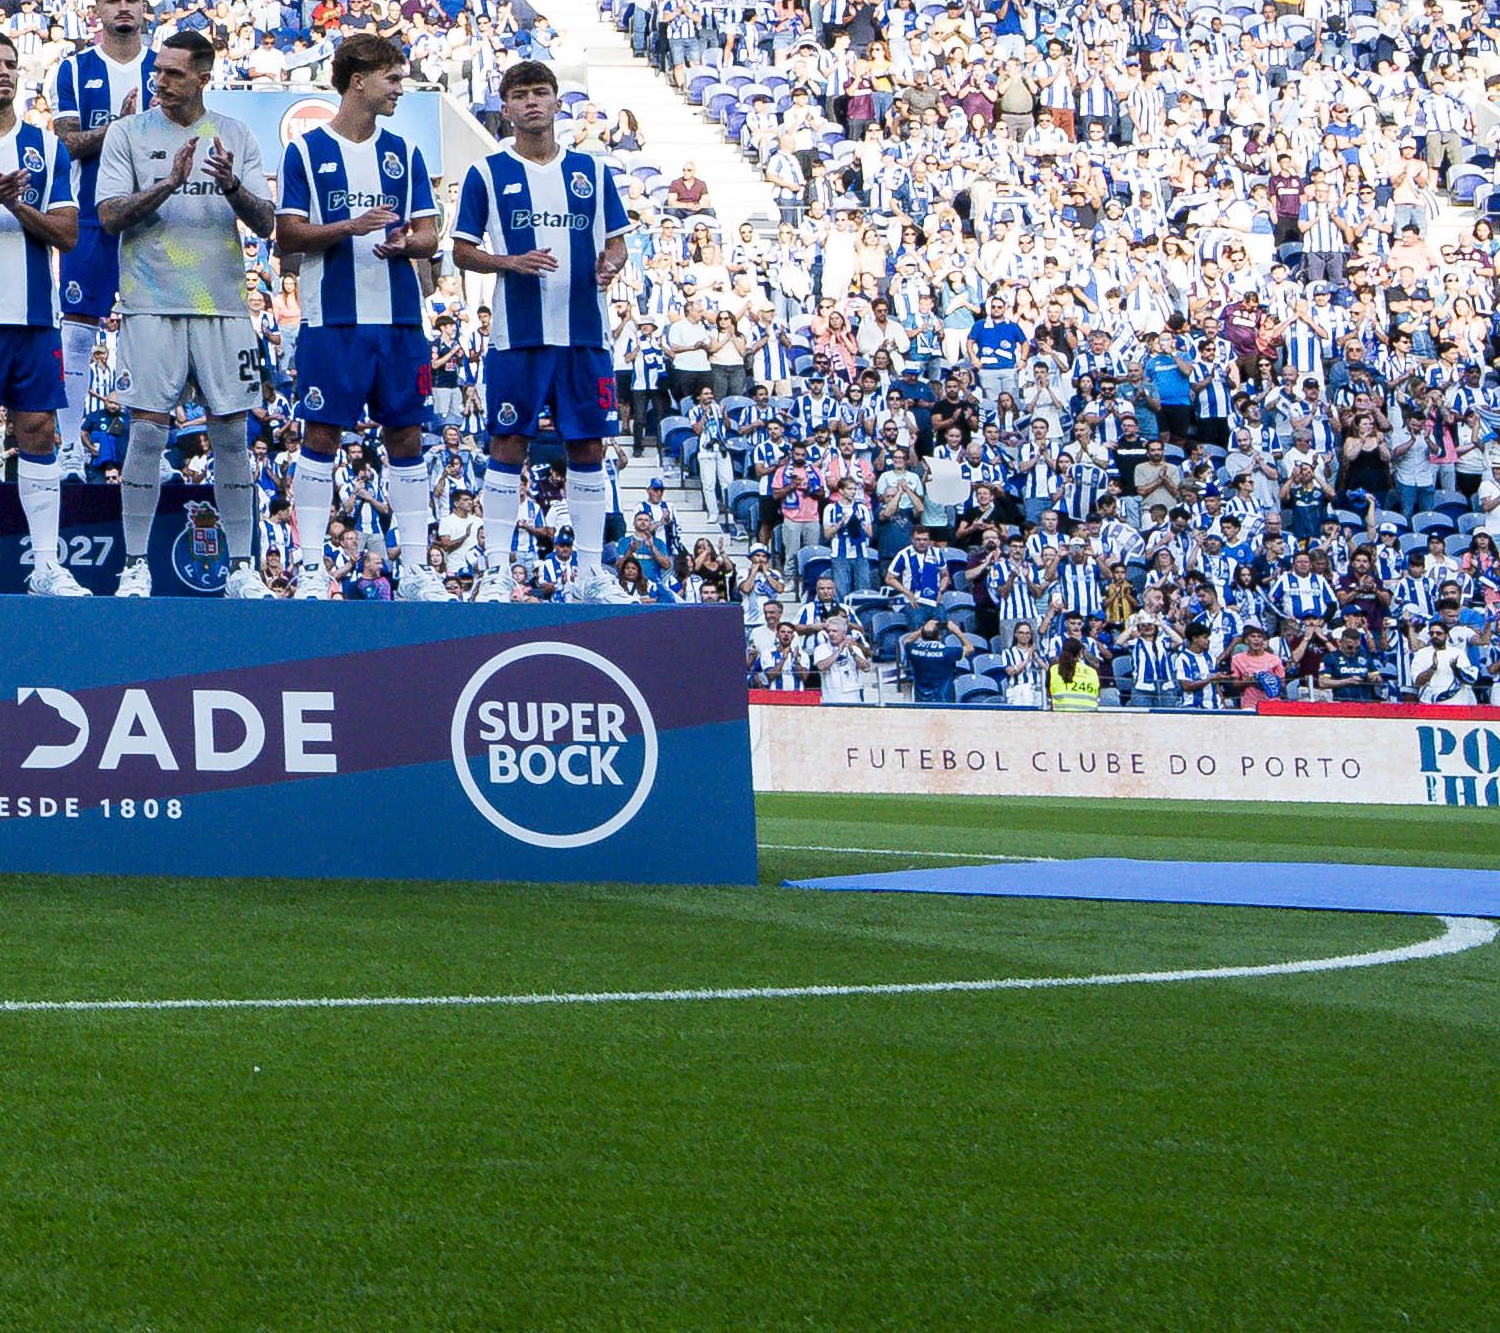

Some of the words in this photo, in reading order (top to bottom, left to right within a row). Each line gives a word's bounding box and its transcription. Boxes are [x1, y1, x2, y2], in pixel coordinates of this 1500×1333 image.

[327, 190, 399, 212] Betano
[510, 209, 589, 233] Betano
[18, 536, 114, 567] 227
[478, 700, 628, 745] SUPER
[487, 744, 623, 787] BOCK
[846, 746, 1009, 772] FUTEBOL
[1031, 751, 1146, 776] CLUBE
[1169, 753, 1218, 778] DO
[1242, 755, 1364, 780] PORTO
[99, 796, 185, 821] 1808
